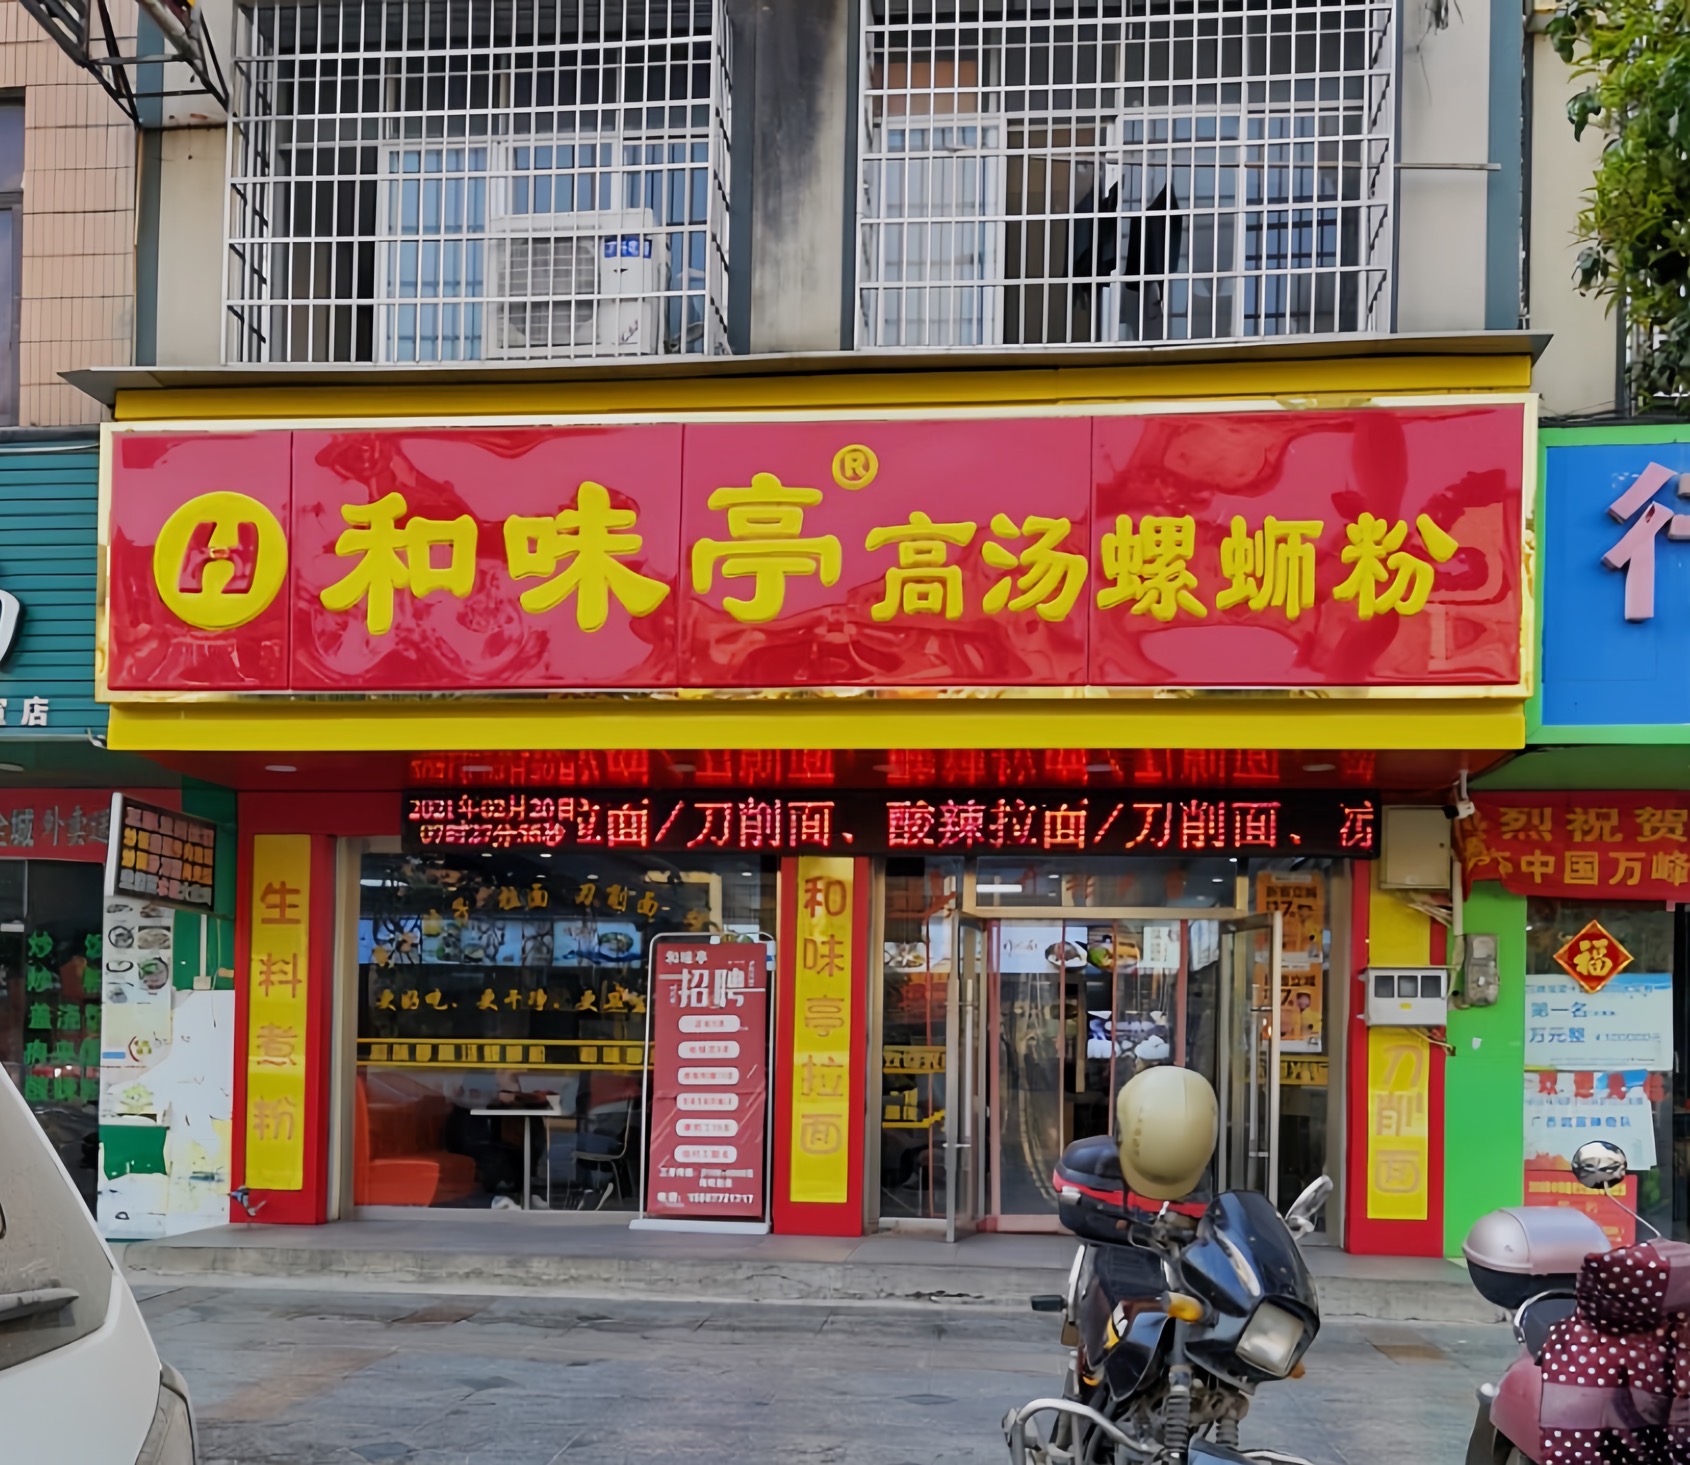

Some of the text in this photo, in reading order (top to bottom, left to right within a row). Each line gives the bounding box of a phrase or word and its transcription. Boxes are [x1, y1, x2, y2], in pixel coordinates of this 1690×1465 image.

[320, 472, 1459, 635] 和味亭 高汤螺蛳粉
[0, 696, 49, 726] 店
[253, 880, 303, 1142] 生料煮粉
[678, 967, 745, 1009] 招聘
[800, 875, 848, 1156] 和味亭拉面
[1573, 938, 1613, 976] 福
[1374, 1042, 1424, 1195] 刀削面
